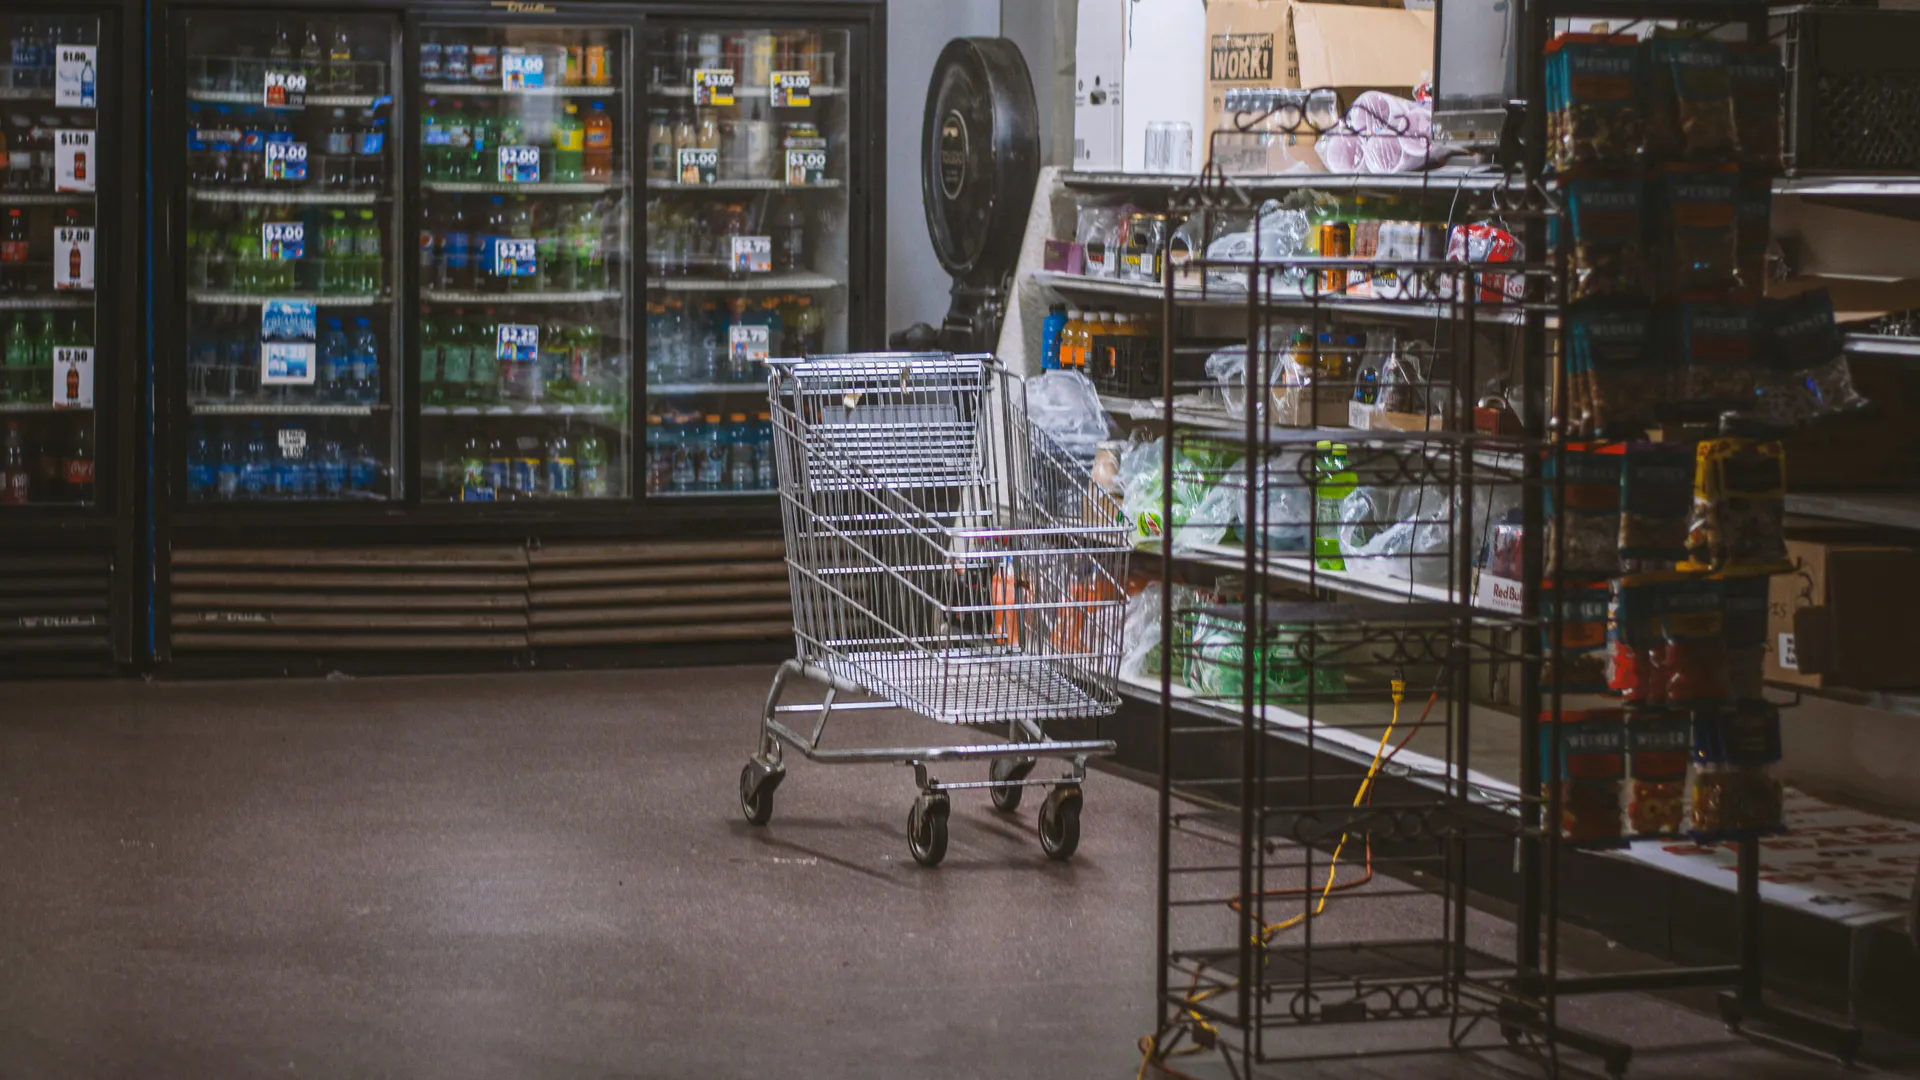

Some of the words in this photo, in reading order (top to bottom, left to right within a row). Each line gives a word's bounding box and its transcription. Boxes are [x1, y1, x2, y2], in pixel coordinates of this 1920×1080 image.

[63, 51, 87, 62] $1.00
[1213, 49, 1269, 79] WORK!
[504, 56, 543, 74] $2.00
[267, 73, 307, 90] $2.00
[705, 74, 734, 87] $3.00
[781, 75, 810, 88] $3.00
[61, 133, 89, 146] $1.50
[269, 143, 307, 161] $2.00
[501, 147, 538, 164] $2.00
[682, 152, 717, 166] $3.00
[790, 152, 826, 167] $3.00
[266, 225, 303, 241] $2.00
[500, 242, 536, 259] $2.25
[1494, 583, 1508, 600] Red
